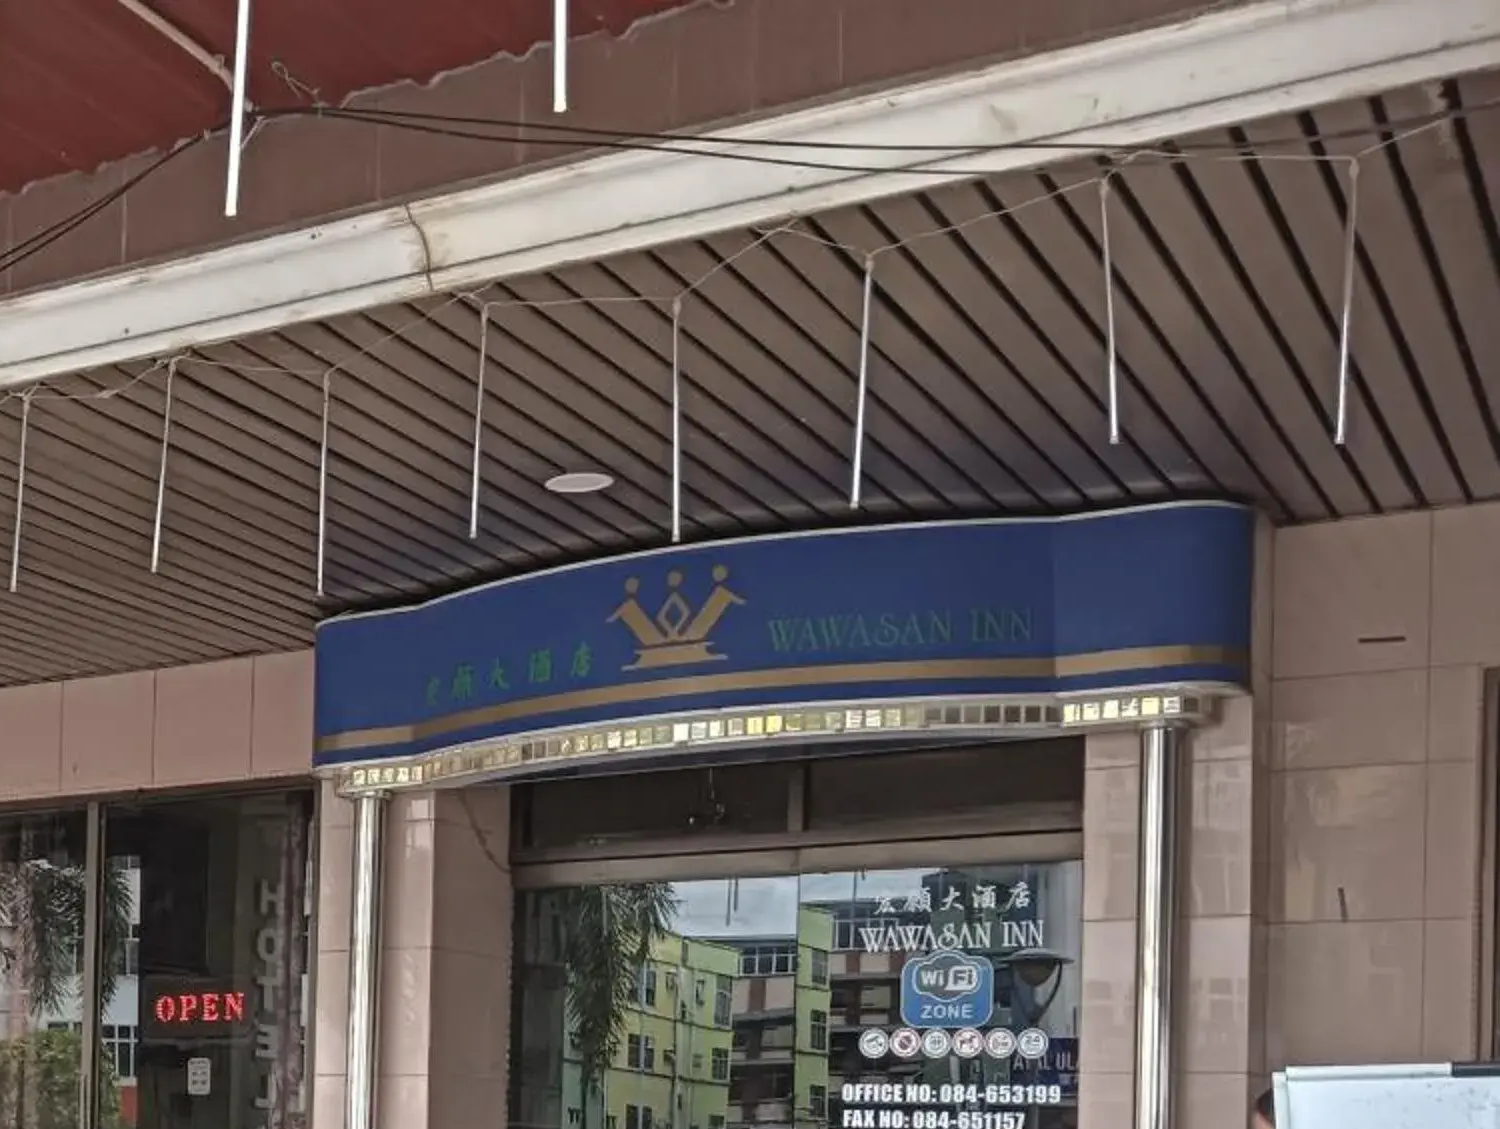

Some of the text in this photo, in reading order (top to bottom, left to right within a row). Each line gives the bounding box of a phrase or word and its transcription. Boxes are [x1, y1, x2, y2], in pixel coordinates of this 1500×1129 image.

[767, 607, 1032, 652] WAWASAN INN
[858, 919, 1045, 953] WAWASAN INN
[155, 992, 245, 1022] OPEN
[920, 1003, 974, 1020] ZONE
[841, 1083, 1062, 1104] OFFICE NO: 084-653199
[843, 1111, 875, 1129] FAX
[879, 1111, 910, 1129] NO:
